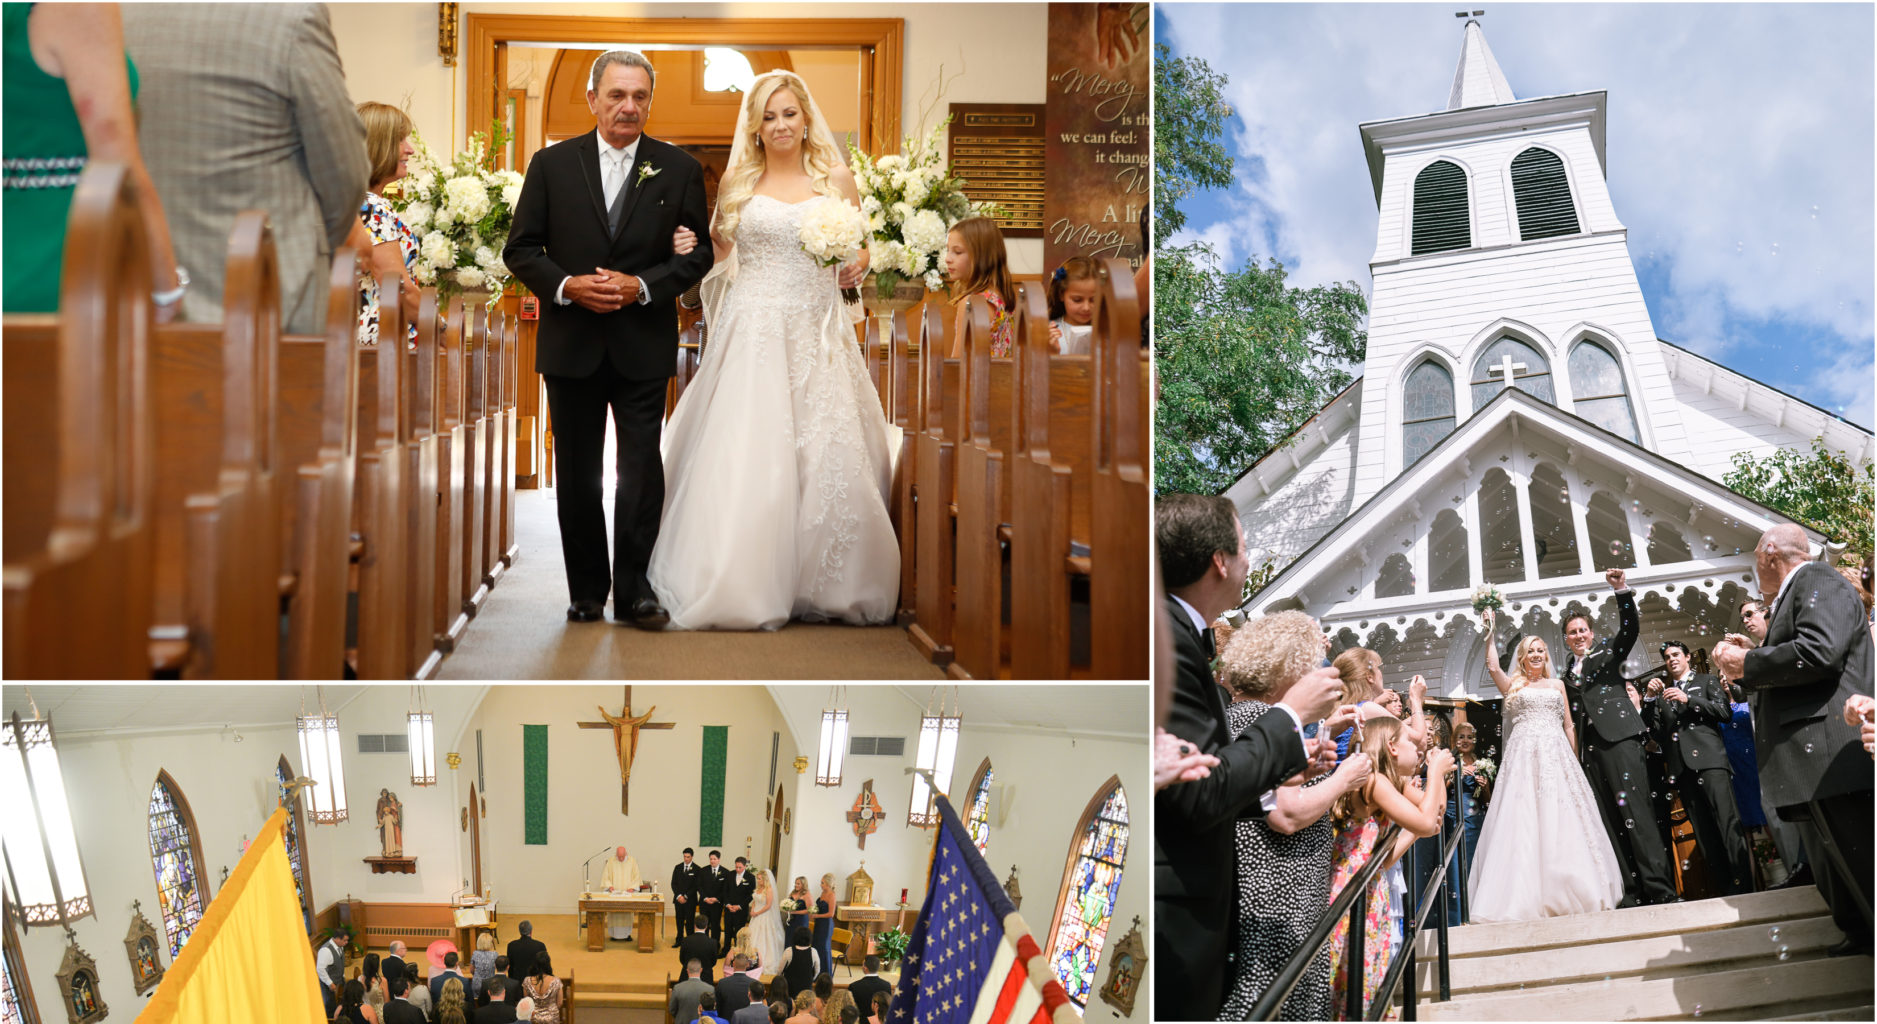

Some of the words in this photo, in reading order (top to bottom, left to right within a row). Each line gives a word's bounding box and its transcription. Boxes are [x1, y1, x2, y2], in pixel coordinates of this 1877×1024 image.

[1122, 113, 1132, 126] is
[1061, 133, 1080, 143] we
[1083, 133, 1106, 144] can
[1110, 130, 1137, 144] feel:
[1096, 150, 1105, 163] it
[1102, 204, 1118, 223] A
[1050, 217, 1136, 259] Mercy
